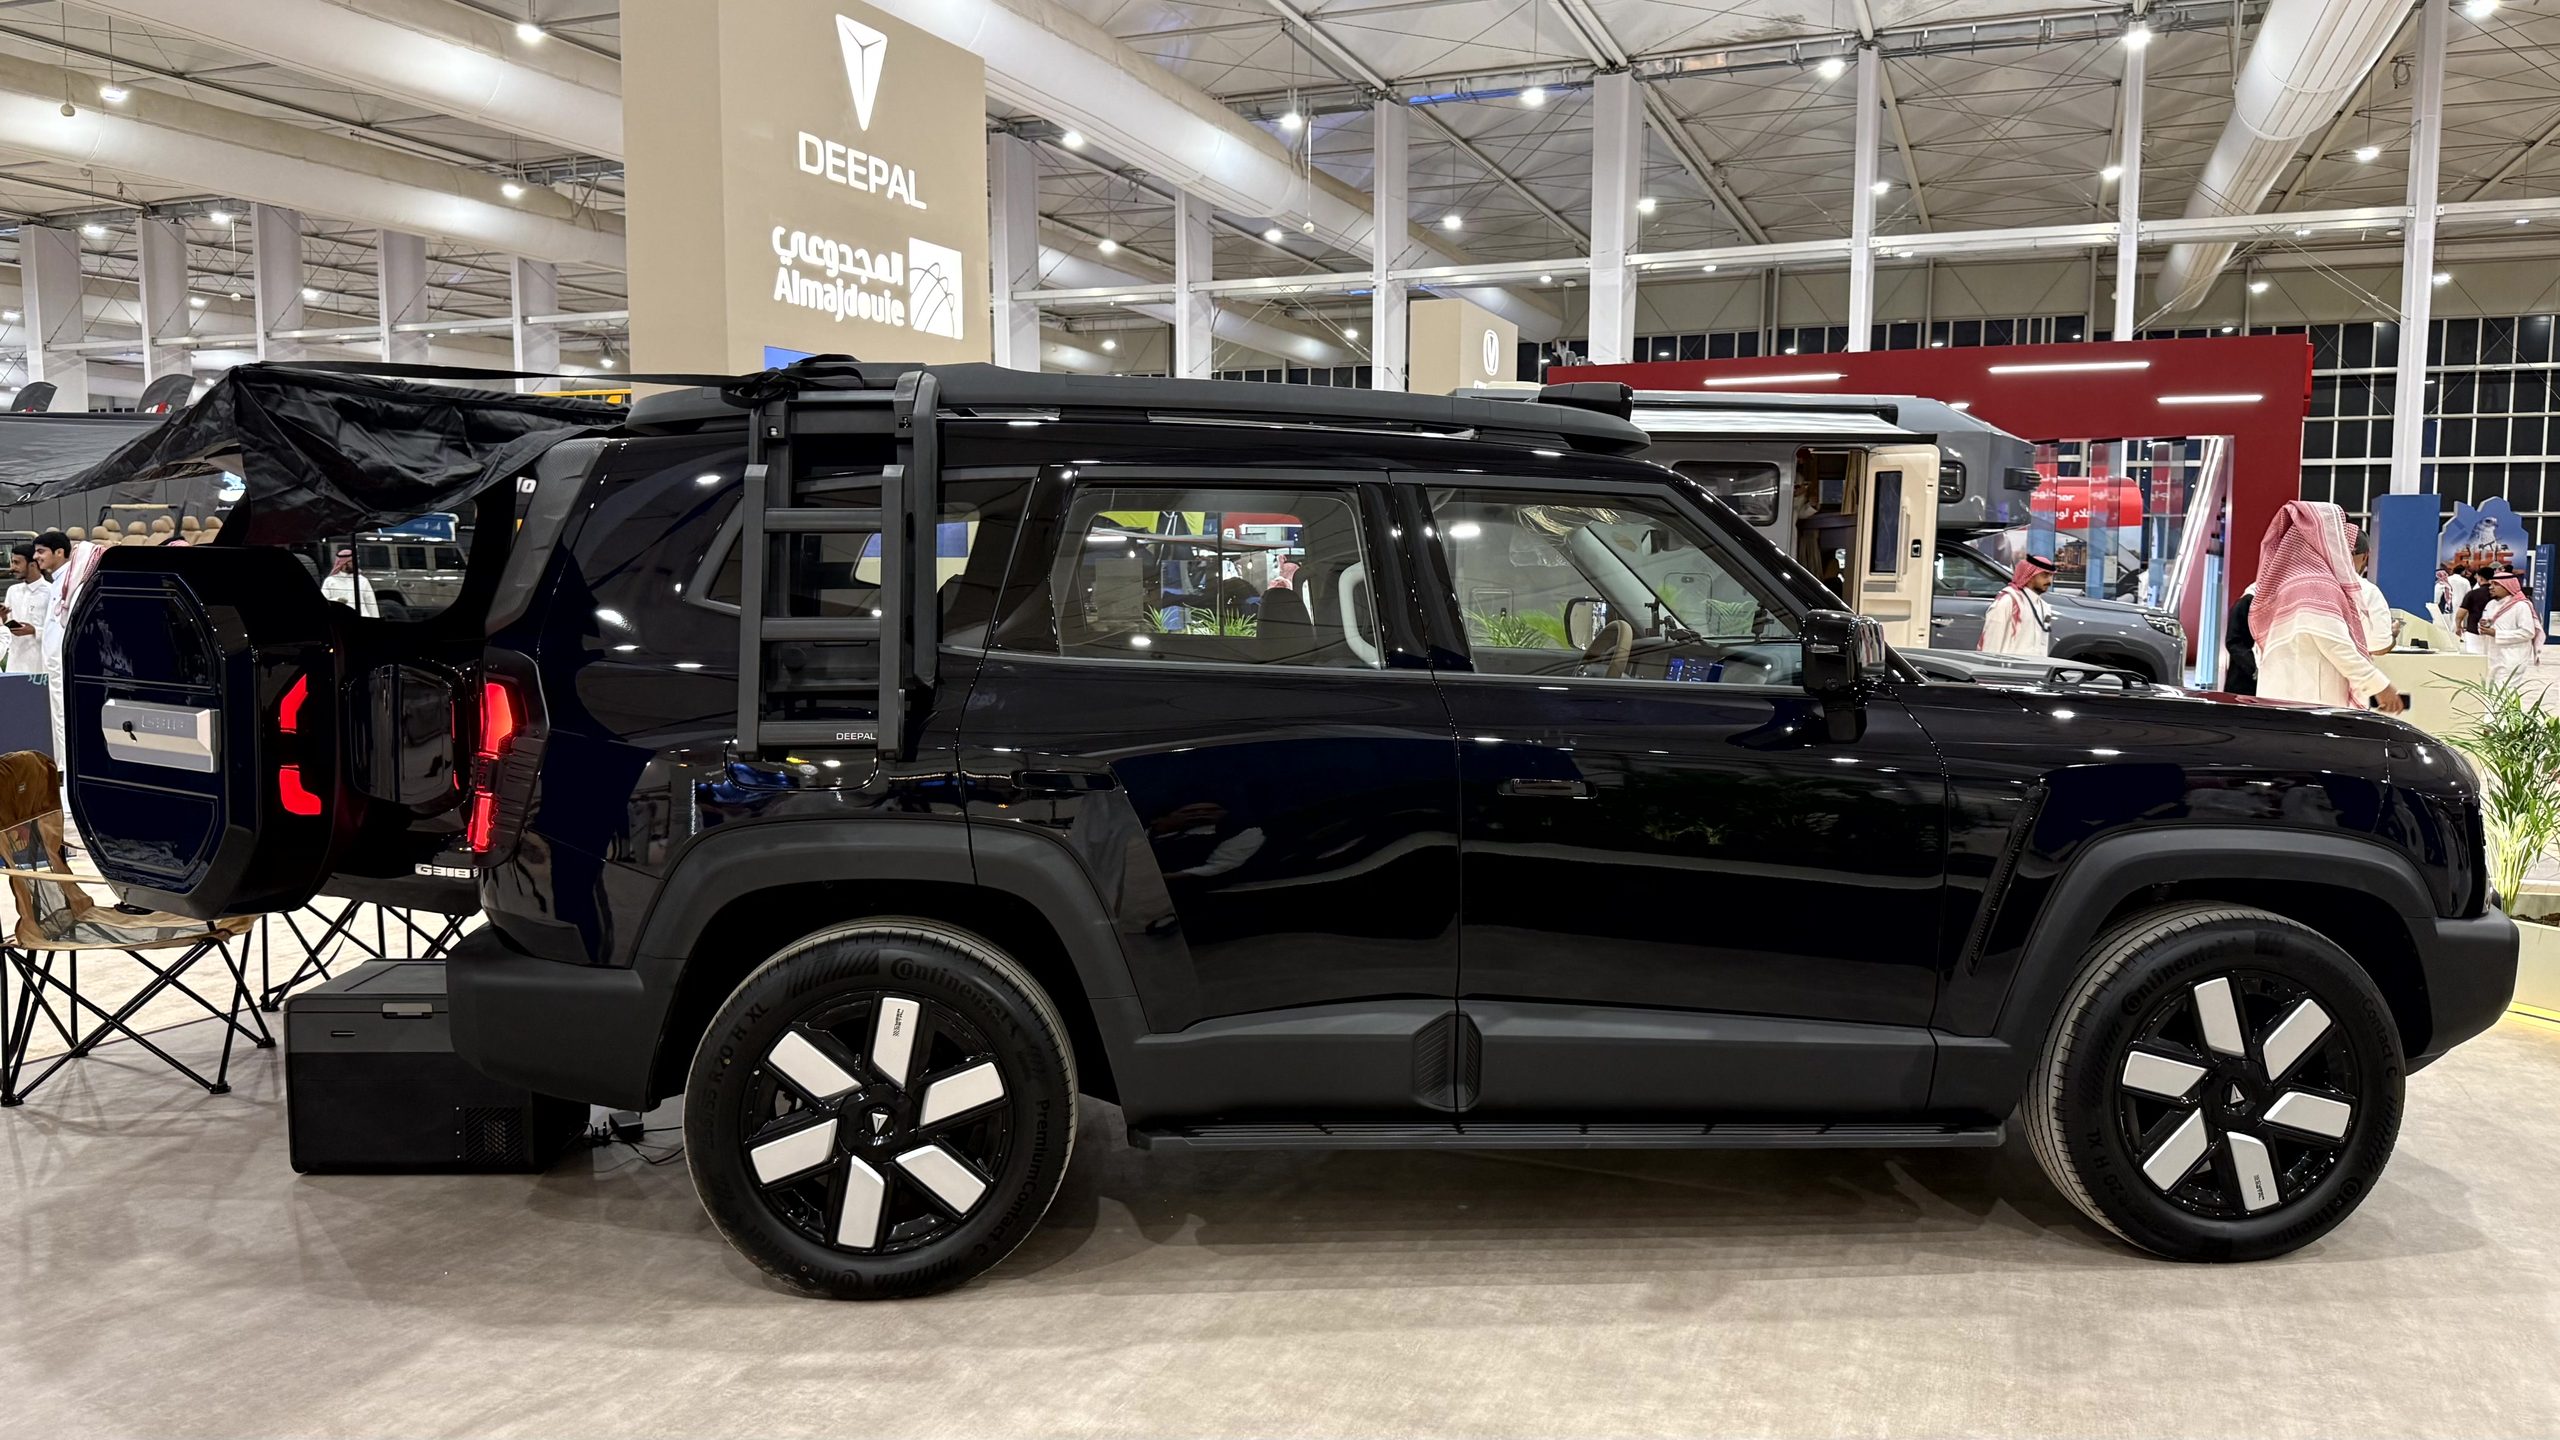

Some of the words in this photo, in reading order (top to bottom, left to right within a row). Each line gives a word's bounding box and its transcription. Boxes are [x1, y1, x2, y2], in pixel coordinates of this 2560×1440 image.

[798, 131, 927, 210] DEEPAL
[772, 225, 904, 286] المجدوعي
[774, 267, 905, 327] Almajdouie
[836, 732, 877, 740] DEEPAL
[415, 863, 471, 879] G318
[890, 956, 1010, 1025] Continental
[731, 1025, 747, 1040] H
[745, 1002, 770, 1023] XL
[2087, 1127, 2104, 1148] XL
